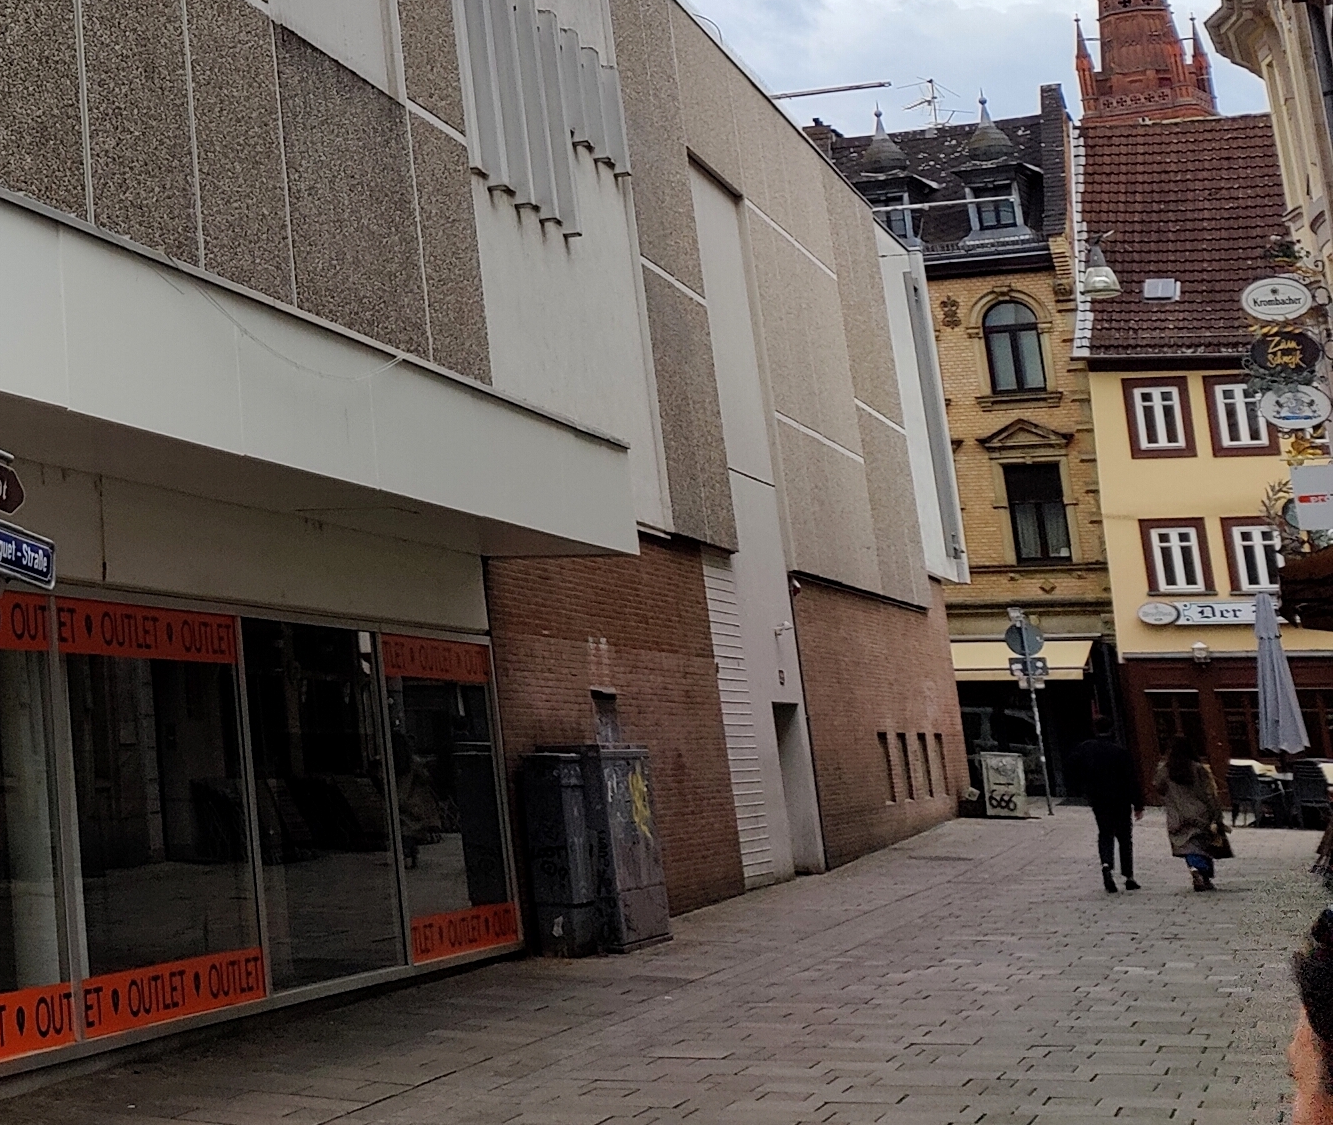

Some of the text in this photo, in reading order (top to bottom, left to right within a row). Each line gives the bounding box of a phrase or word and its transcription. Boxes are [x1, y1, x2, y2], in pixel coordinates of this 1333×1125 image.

[1253, 296, 1302, 307] Krombacher
[1197, 605, 1242, 619] Der
[100, 611, 159, 649] OUTLET
[182, 619, 233, 655] OUTLET
[988, 789, 1017, 812] 666
[127, 969, 186, 1017] OUTLET
[208, 956, 261, 999] OUTLET
